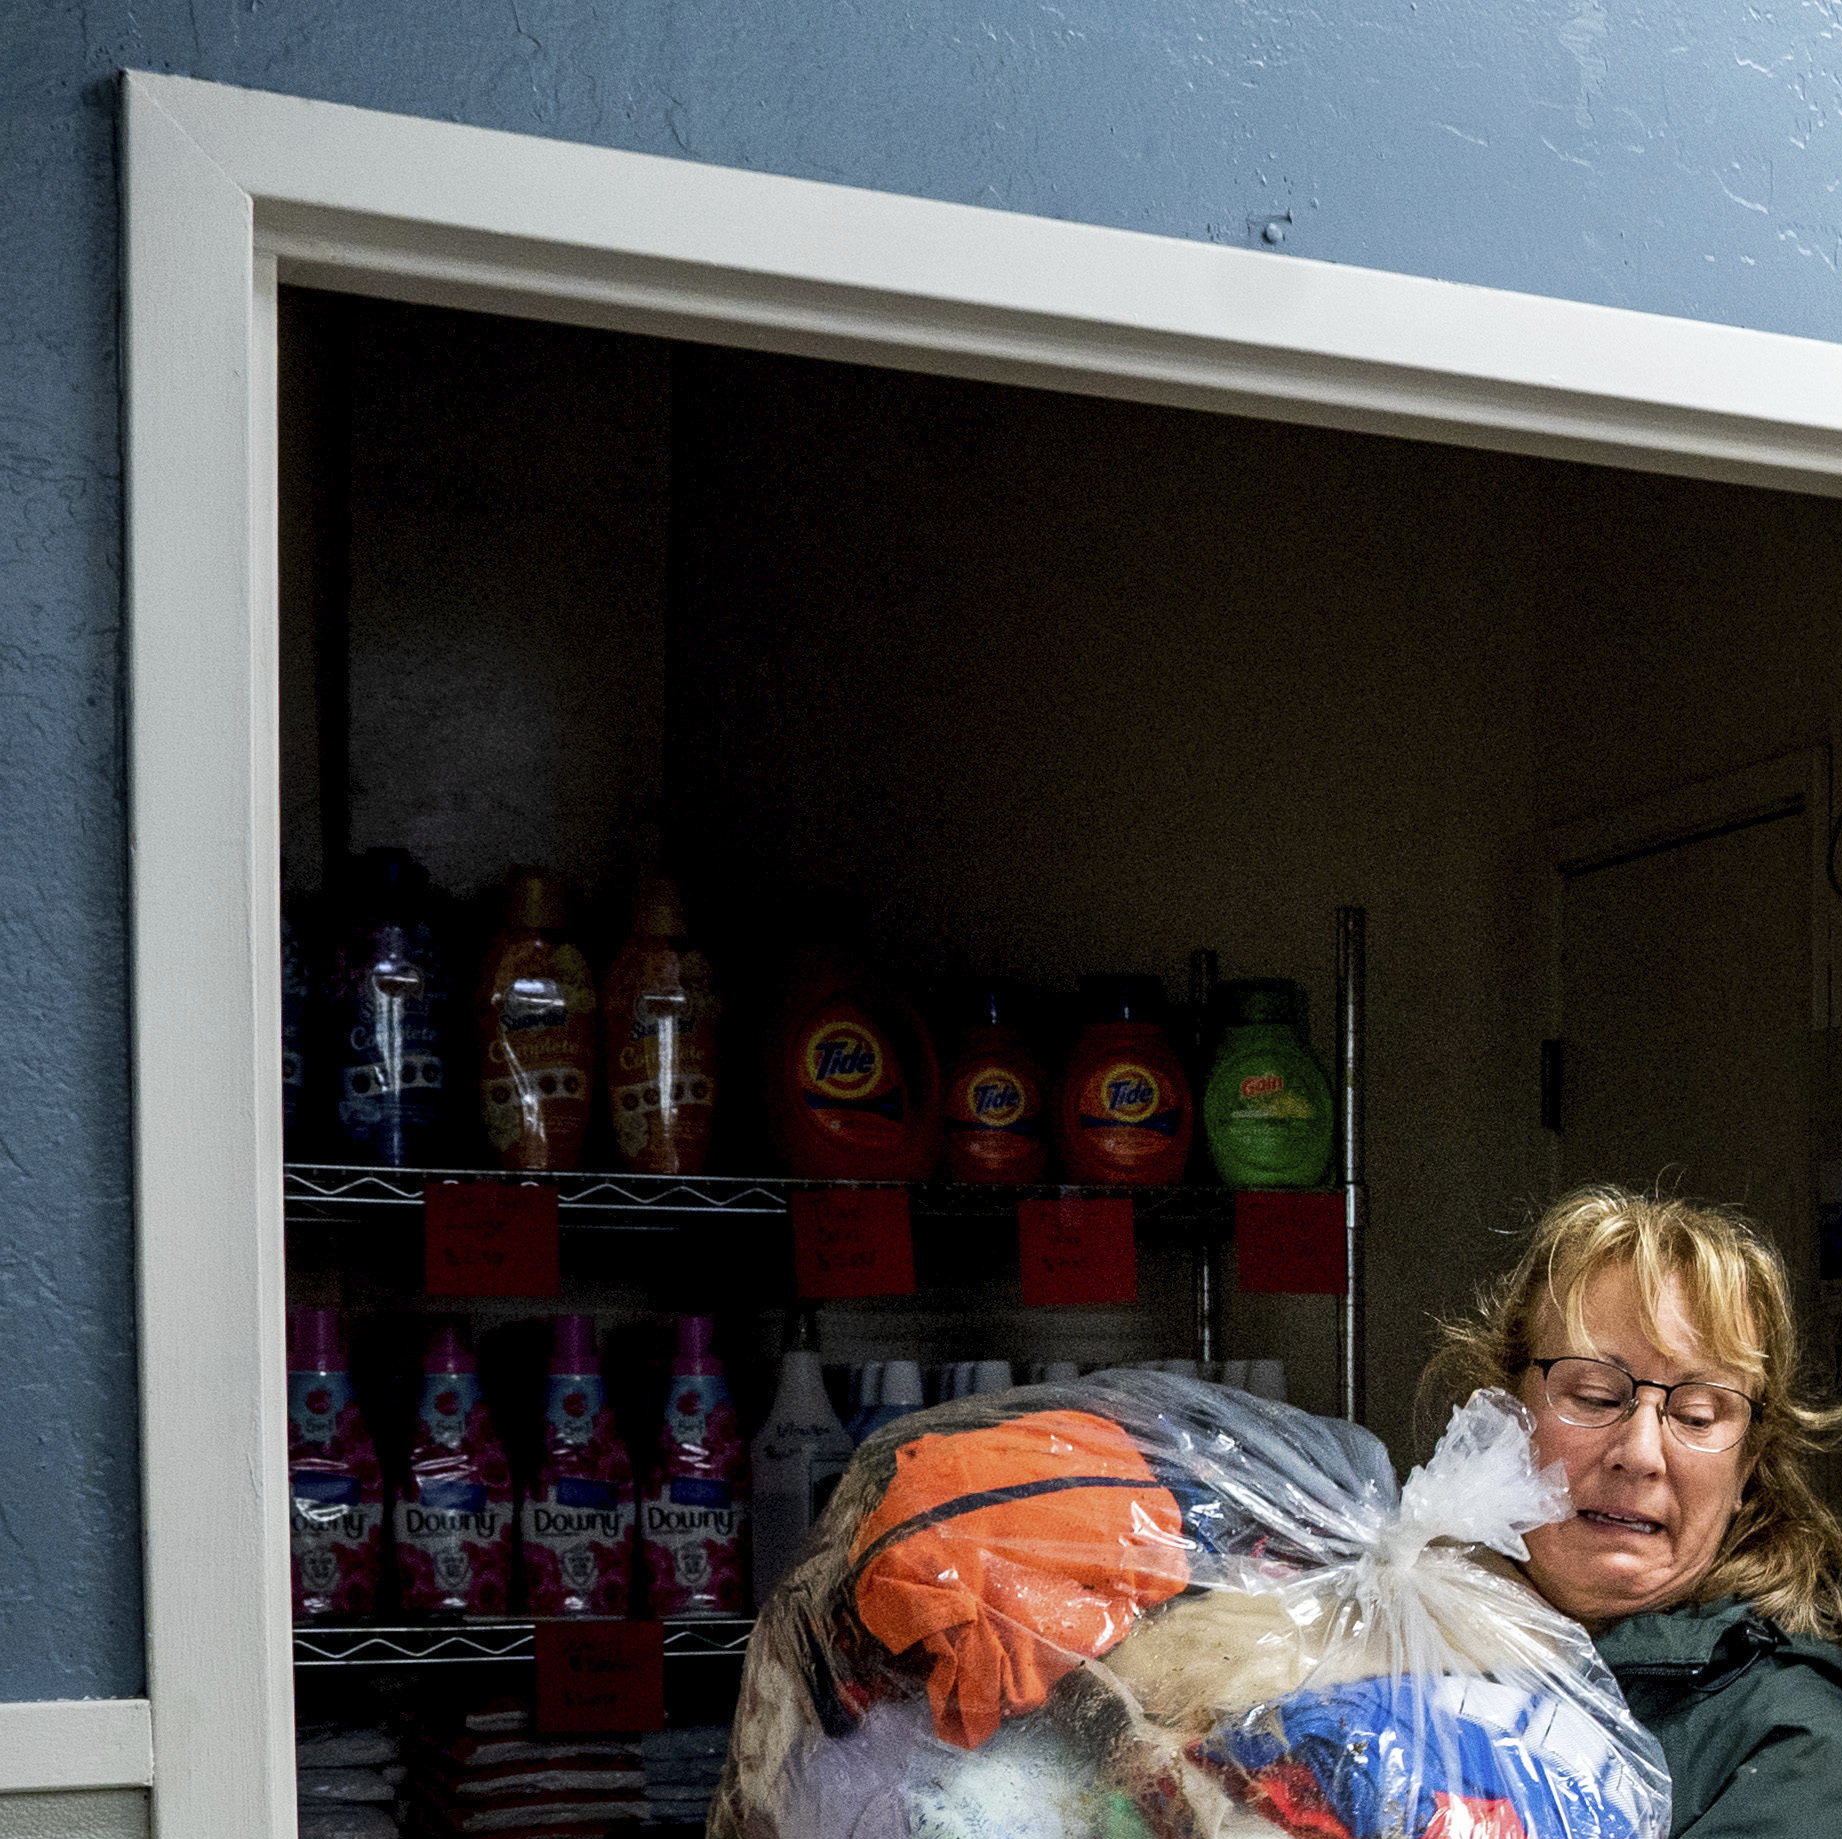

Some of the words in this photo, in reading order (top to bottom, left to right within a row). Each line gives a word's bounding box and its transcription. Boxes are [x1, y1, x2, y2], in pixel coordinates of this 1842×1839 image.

[815, 1039, 876, 1082] Tide
[974, 1083, 1022, 1115] Tide
[1106, 1079, 1154, 1112] Tide
[1240, 1074, 1285, 1099] Gain
[406, 1508, 498, 1538] Downy
[534, 1508, 621, 1538] Downy
[648, 1506, 735, 1535] Downy
